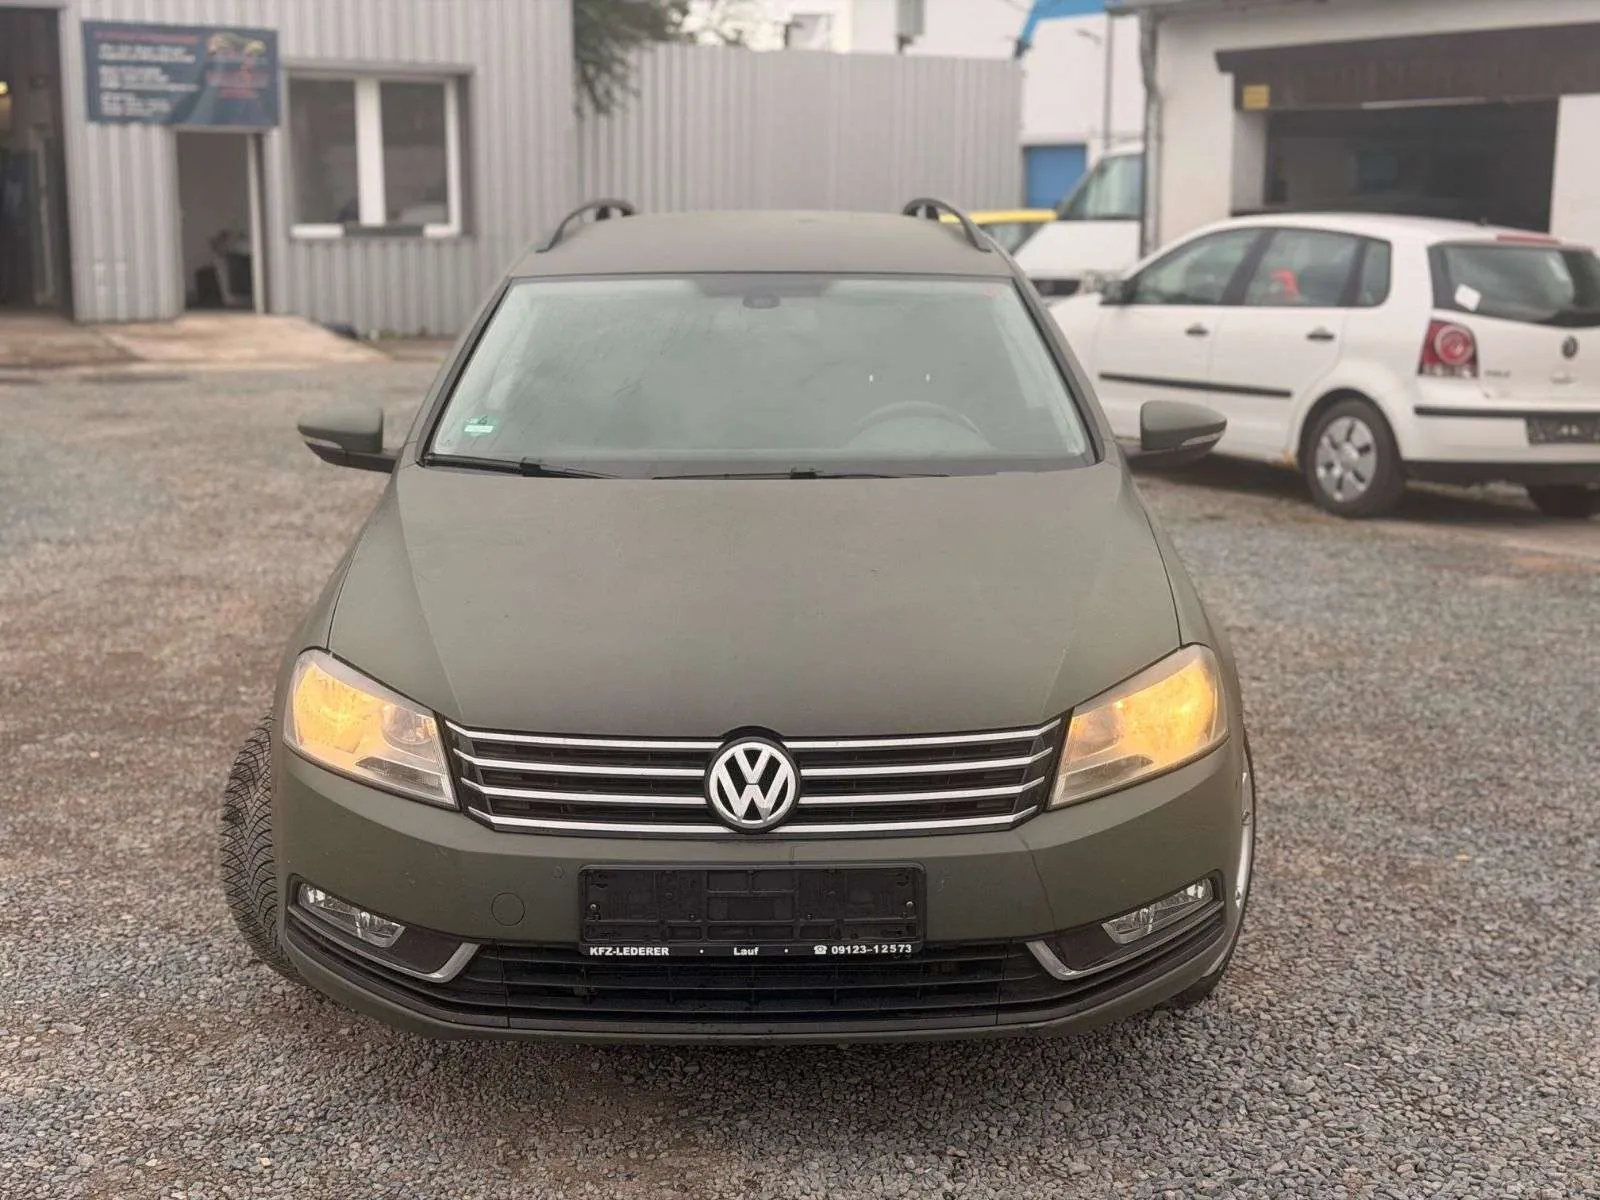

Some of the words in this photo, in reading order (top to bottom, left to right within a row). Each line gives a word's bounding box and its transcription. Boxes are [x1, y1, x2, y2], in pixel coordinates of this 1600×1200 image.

[708, 741, 796, 825] VW
[589, 946, 670, 956] KFZ-LEDERER
[733, 946, 759, 956] Lauf
[831, 944, 912, 955] 09123-12573
